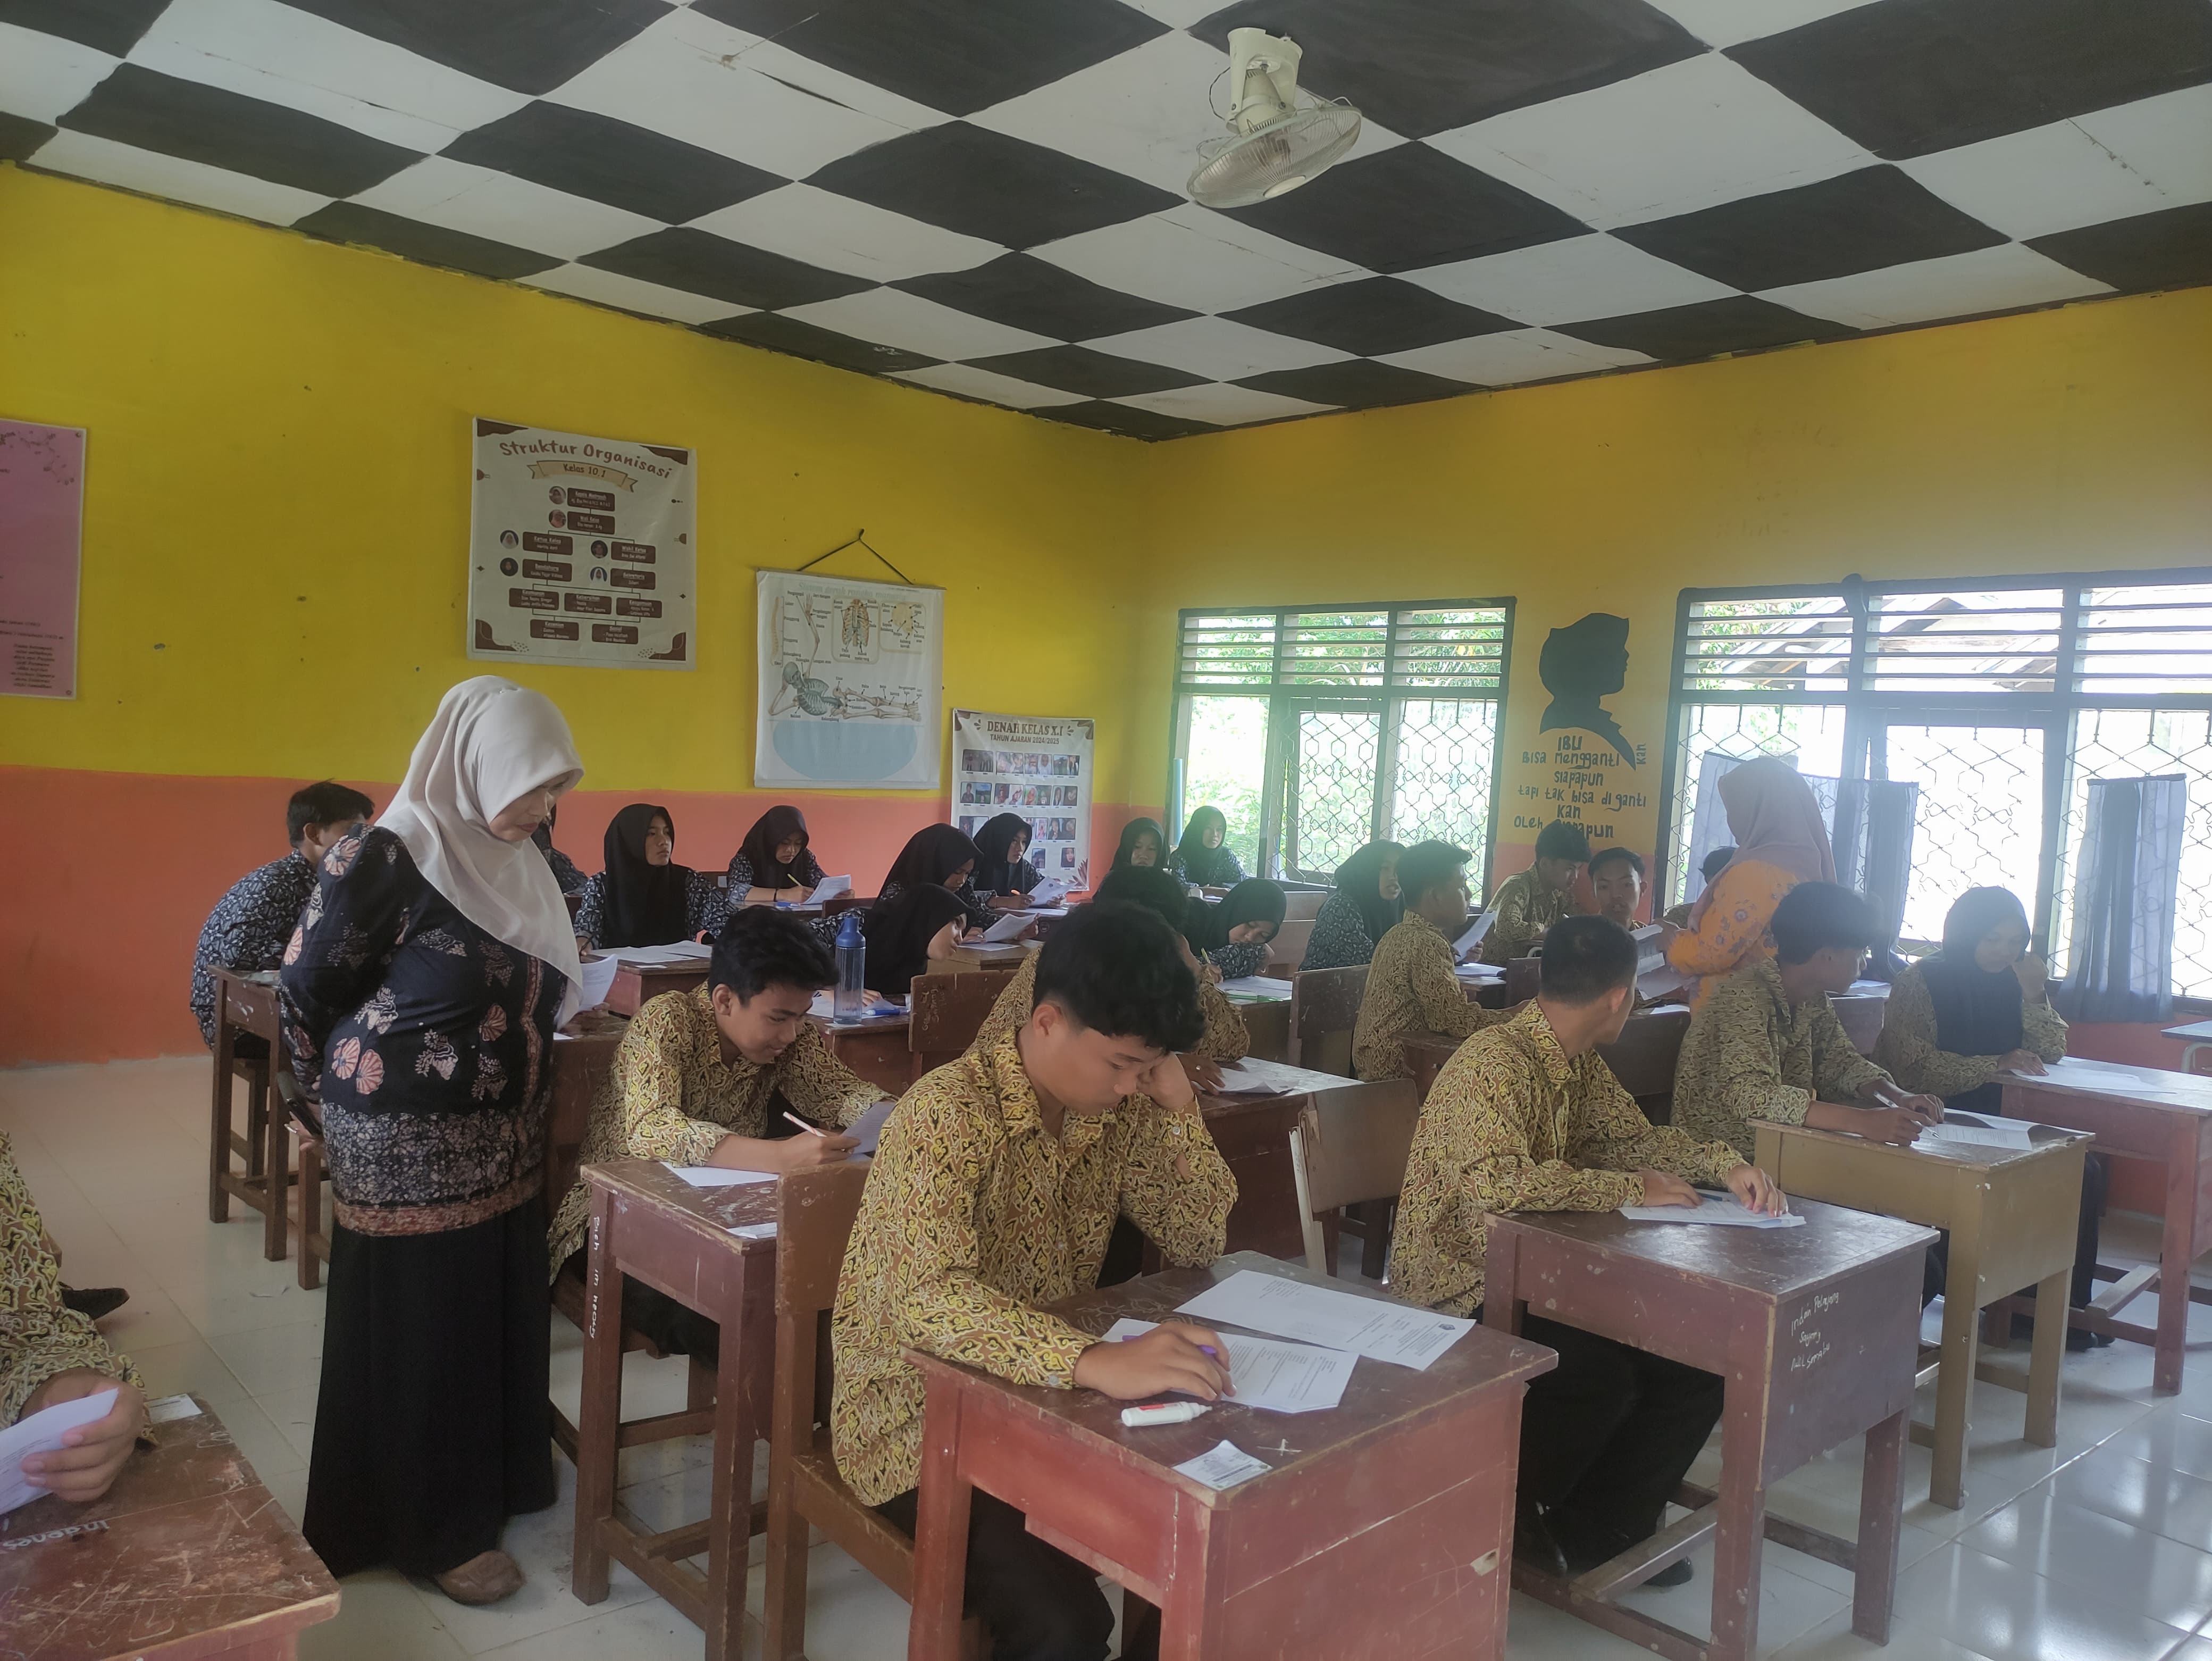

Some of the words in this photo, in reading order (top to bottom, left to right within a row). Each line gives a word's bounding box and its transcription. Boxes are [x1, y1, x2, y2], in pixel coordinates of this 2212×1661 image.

[500, 440, 579, 456] Struktur
[583, 444, 673, 479] Organisasi
[563, 463, 584, 473] Kelas
[987, 721, 1020, 733] DENAH
[1021, 723, 1050, 735] KELAS
[1557, 736, 1582, 751] IBU
